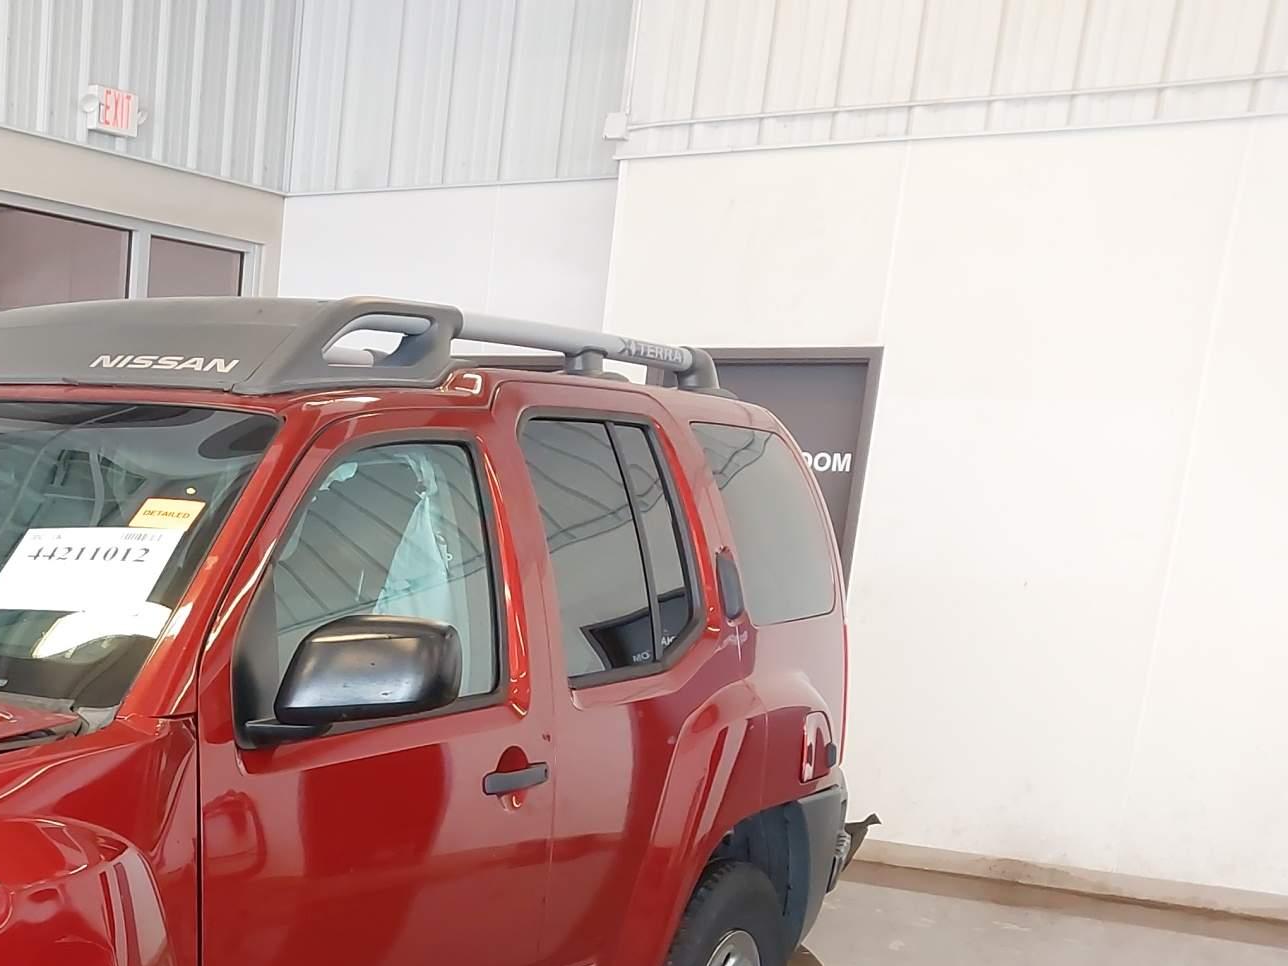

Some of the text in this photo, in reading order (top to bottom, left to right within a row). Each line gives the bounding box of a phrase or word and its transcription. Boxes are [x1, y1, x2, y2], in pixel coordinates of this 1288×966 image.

[104, 89, 132, 129] EXIT
[89, 354, 240, 373] NISSAN
[142, 509, 191, 519] DETAILED
[27, 546, 150, 564] 44211012
